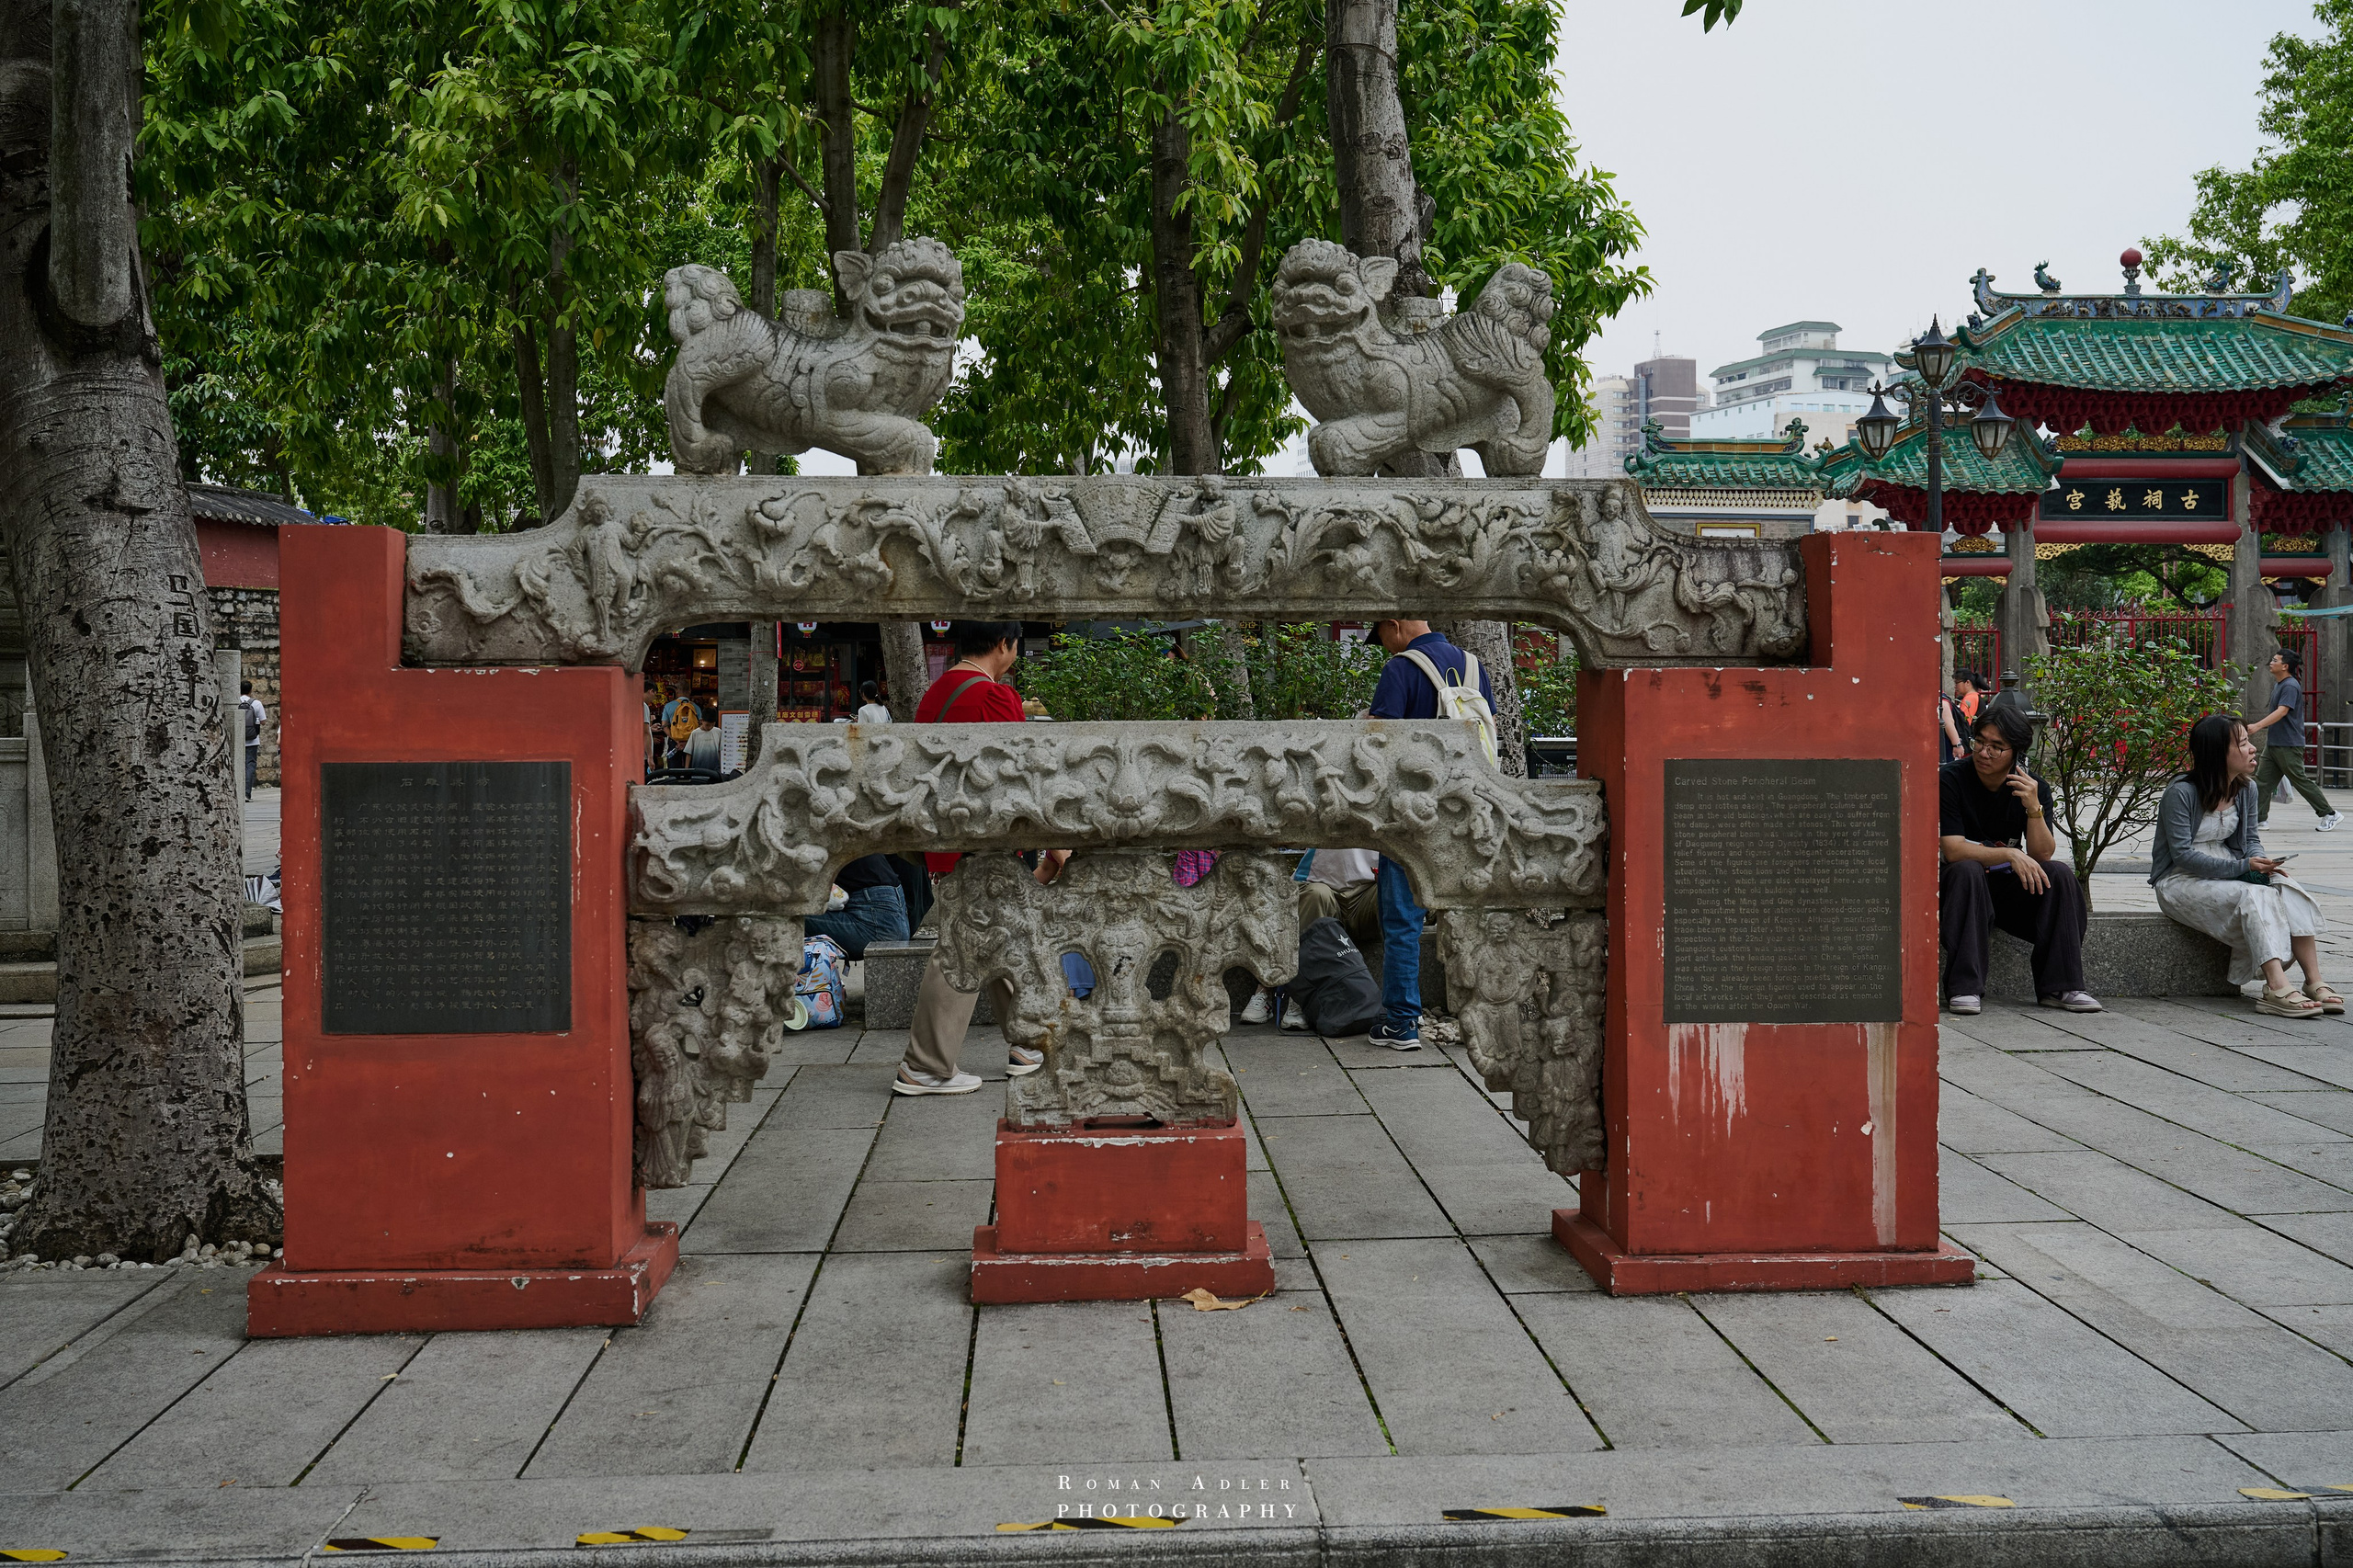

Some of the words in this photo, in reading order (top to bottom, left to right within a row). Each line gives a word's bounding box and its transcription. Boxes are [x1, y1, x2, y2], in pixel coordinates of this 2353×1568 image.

[1675, 776, 1707, 785] Carved
[1711, 776, 1737, 785] Stone
[1717, 792, 1729, 801] hot
[1733, 792, 1746, 801] and
[1826, 792, 1839, 801] The
[1844, 792, 1867, 801] timber
[1871, 792, 1887, 801] gets
[1675, 801, 1695, 812] damp
[1699, 801, 1711, 810] and
[1715, 801, 1738, 810] rotten
[1772, 801, 1785, 809] The
[1789, 801, 1826, 811] peripheral
[1859, 801, 1872, 809] and
[1674, 811, 1693, 819] beam
[1723, 811, 1733, 819] old
[1847, 811, 1870, 819] suffer
[1873, 811, 1890, 819] from
[1740, 820, 1759, 828] often
[1764, 819, 1783, 827] made
[1831, 819, 1846, 827] This
[1850, 819, 1876, 827] carved
[1675, 829, 1695, 838] stone
[1699, 829, 1736, 839] peripheral
[1740, 829, 1760, 837] beam
[1833, 831, 1848, 839] year
[1686, 838, 1722, 848] Daoguang
[1863, 838, 1888, 846] carved
[1674, 848, 1693, 857] relief
[1697, 848, 1724, 857] flowers
[1729, 848, 1742, 857] and
[1795, 847, 1822, 858] elegant
[1675, 858, 1695, 866] Some
[1727, 858, 1752, 868] figures
[1772, 857, 1809, 867] foreigners
[1813, 857, 1848, 867] reflecting
[1869, 857, 1886, 865] local
[1714, 867, 1728, 875] The
[1732, 867, 1752, 875] stone
[1777, 866, 1790, 875] and
[1862, 866, 1888, 874] carved
[1675, 876, 1690, 884] with
[1735, 876, 1756, 884] which
[1776, 876, 1790, 884] also
[1794, 876, 1830, 886] displayed
[1675, 886, 1719, 896] components
[1697, 896, 1720, 906] During
[1740, 896, 1756, 906] Ming
[1761, 896, 1773, 904] and
[1778, 896, 1793, 906] Qing
[1841, 896, 1860, 904] there
[1675, 906, 1688, 915] ban
[1703, 905, 1735, 914] maritime
[1739, 905, 1759, 914] trade
[1820, 905, 1864, 914] closed-door
[1675, 915, 1711, 926] especially
[1807, 915, 1840, 925] Although
[1844, 915, 1875, 923] maritime
[1675, 925, 1693, 933] trade
[1698, 925, 1726, 933] became
[1776, 924, 1795, 932] there
[1861, 924, 1892, 932] customs
[1745, 934, 1763, 942] 22nd
[1767, 936, 1783, 944] year
[1675, 944, 1715, 954] Guangdong
[1720, 944, 1750, 952] customs
[1838, 943, 1853, 951] sole
[1676, 954, 1691, 963] port
[1695, 953, 1708, 961] and
[1712, 953, 1728, 961] took
[1748, 953, 1774, 963] leading
[1852, 952, 1879, 960] Foshan
[1694, 963, 1717, 971] active
[1731, 963, 1743, 971] the
[1746, 963, 1773, 972] foreign
[1814, 962, 1826, 971] the
[1675, 973, 1695, 982] there
[1700, 973, 1714, 982] had
[1722, 973, 1749, 983] already
[1776, 972, 1801, 983] foreign
[1805, 972, 1831, 983] priests
[1835, 972, 1849, 981] who
[1721, 983, 1733, 991] the
[1738, 983, 1765, 993] foreign
[1798, 983, 1814, 991] used
[1870, 982, 1882, 990] the
[1675, 993, 1692, 1001] local
[1696, 993, 1707, 1001] art
[1741, 992, 1753, 1000] but
[1757, 992, 1773, 1002] they
[1800, 992, 1836, 1000] described
[1686, 1002, 1697, 1010] the
[1702, 1002, 1724, 1010] works
[1729, 1002, 1747, 1010] after
[1752, 1002, 1763, 1010] the
[1768, 1001, 1790, 1011] Opium
